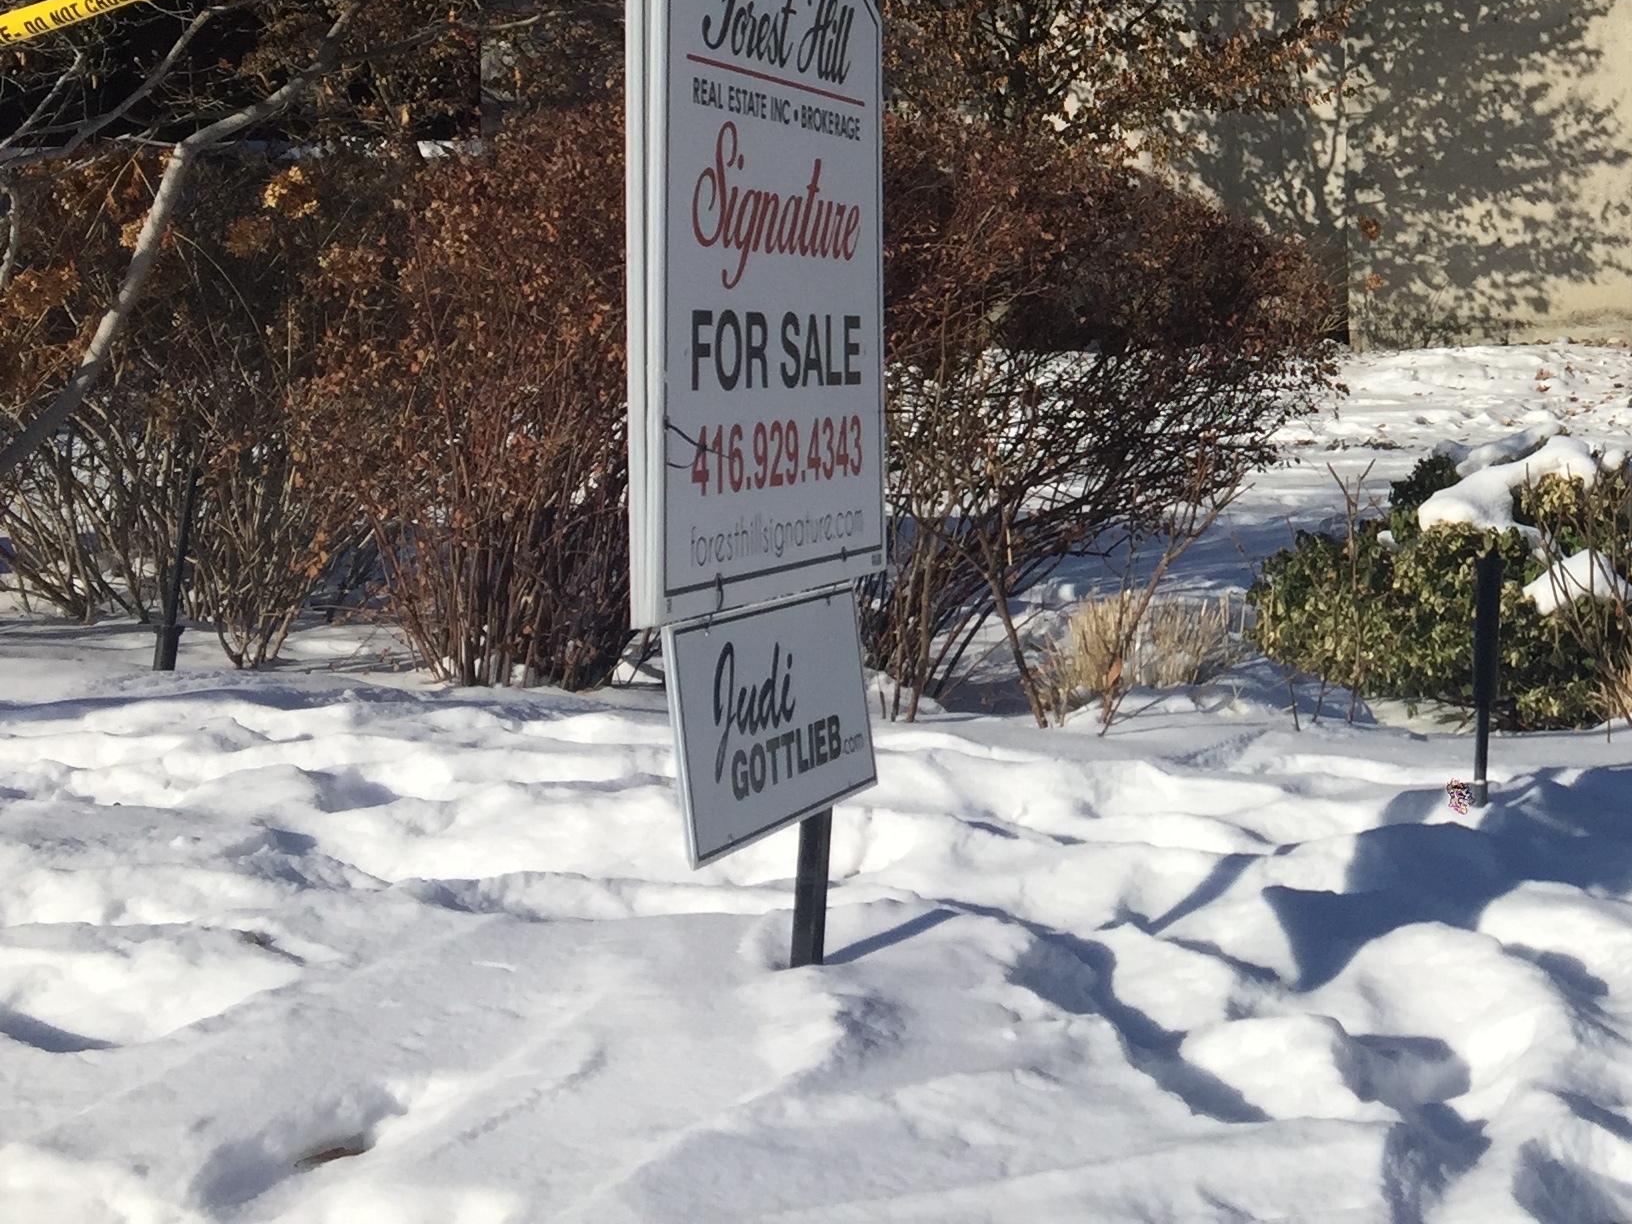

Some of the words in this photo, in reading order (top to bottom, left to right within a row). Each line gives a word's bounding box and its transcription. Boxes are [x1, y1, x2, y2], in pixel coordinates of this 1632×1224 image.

[23, 16, 50, 35] DO
[50, 3, 82, 27] NOT
[693, 76, 725, 110] REAL
[728, 85, 767, 120] ESTATE
[770, 95, 791, 125] INC
[800, 103, 861, 142] BROKERAGE
[692, 121, 861, 290] Signature
[691, 308, 769, 392] FOR
[780, 310, 862, 389] SALE
[691, 414, 863, 497] 416.929.4343
[690, 509, 864, 568] foresthillsignature.com
[713, 641, 796, 785] Judi
